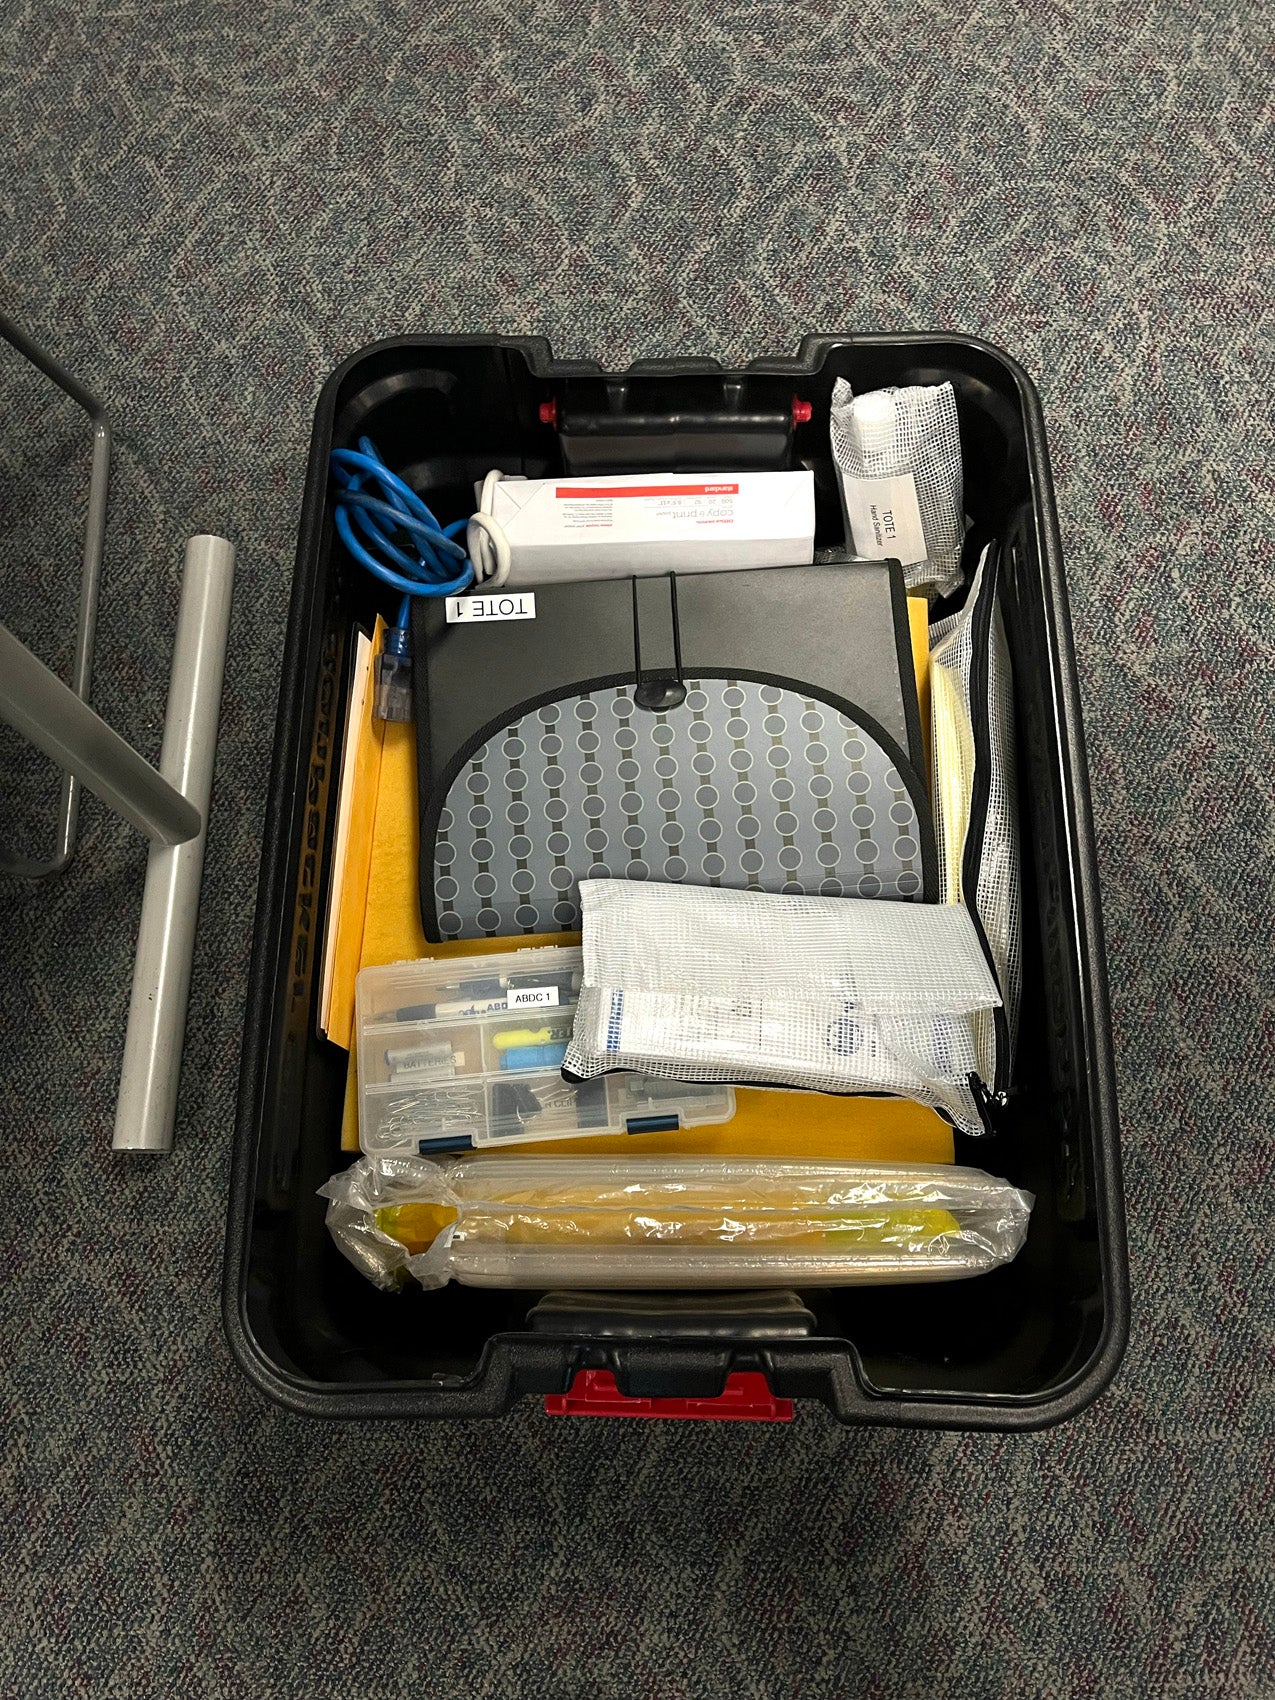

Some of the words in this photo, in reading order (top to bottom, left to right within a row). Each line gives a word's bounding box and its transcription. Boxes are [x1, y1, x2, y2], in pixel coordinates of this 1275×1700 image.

[704, 485, 734, 493] standard
[672, 509, 698, 520] print
[706, 508, 734, 518] copy
[870, 505, 879, 520] Hand
[882, 510, 895, 533] TOTE
[456, 601, 464, 618] 1
[472, 598, 528, 616] TOTE
[515, 993, 543, 1004] ABDC
[546, 993, 551, 1001] 1
[403, 1055, 457, 1069] BATTERIES
